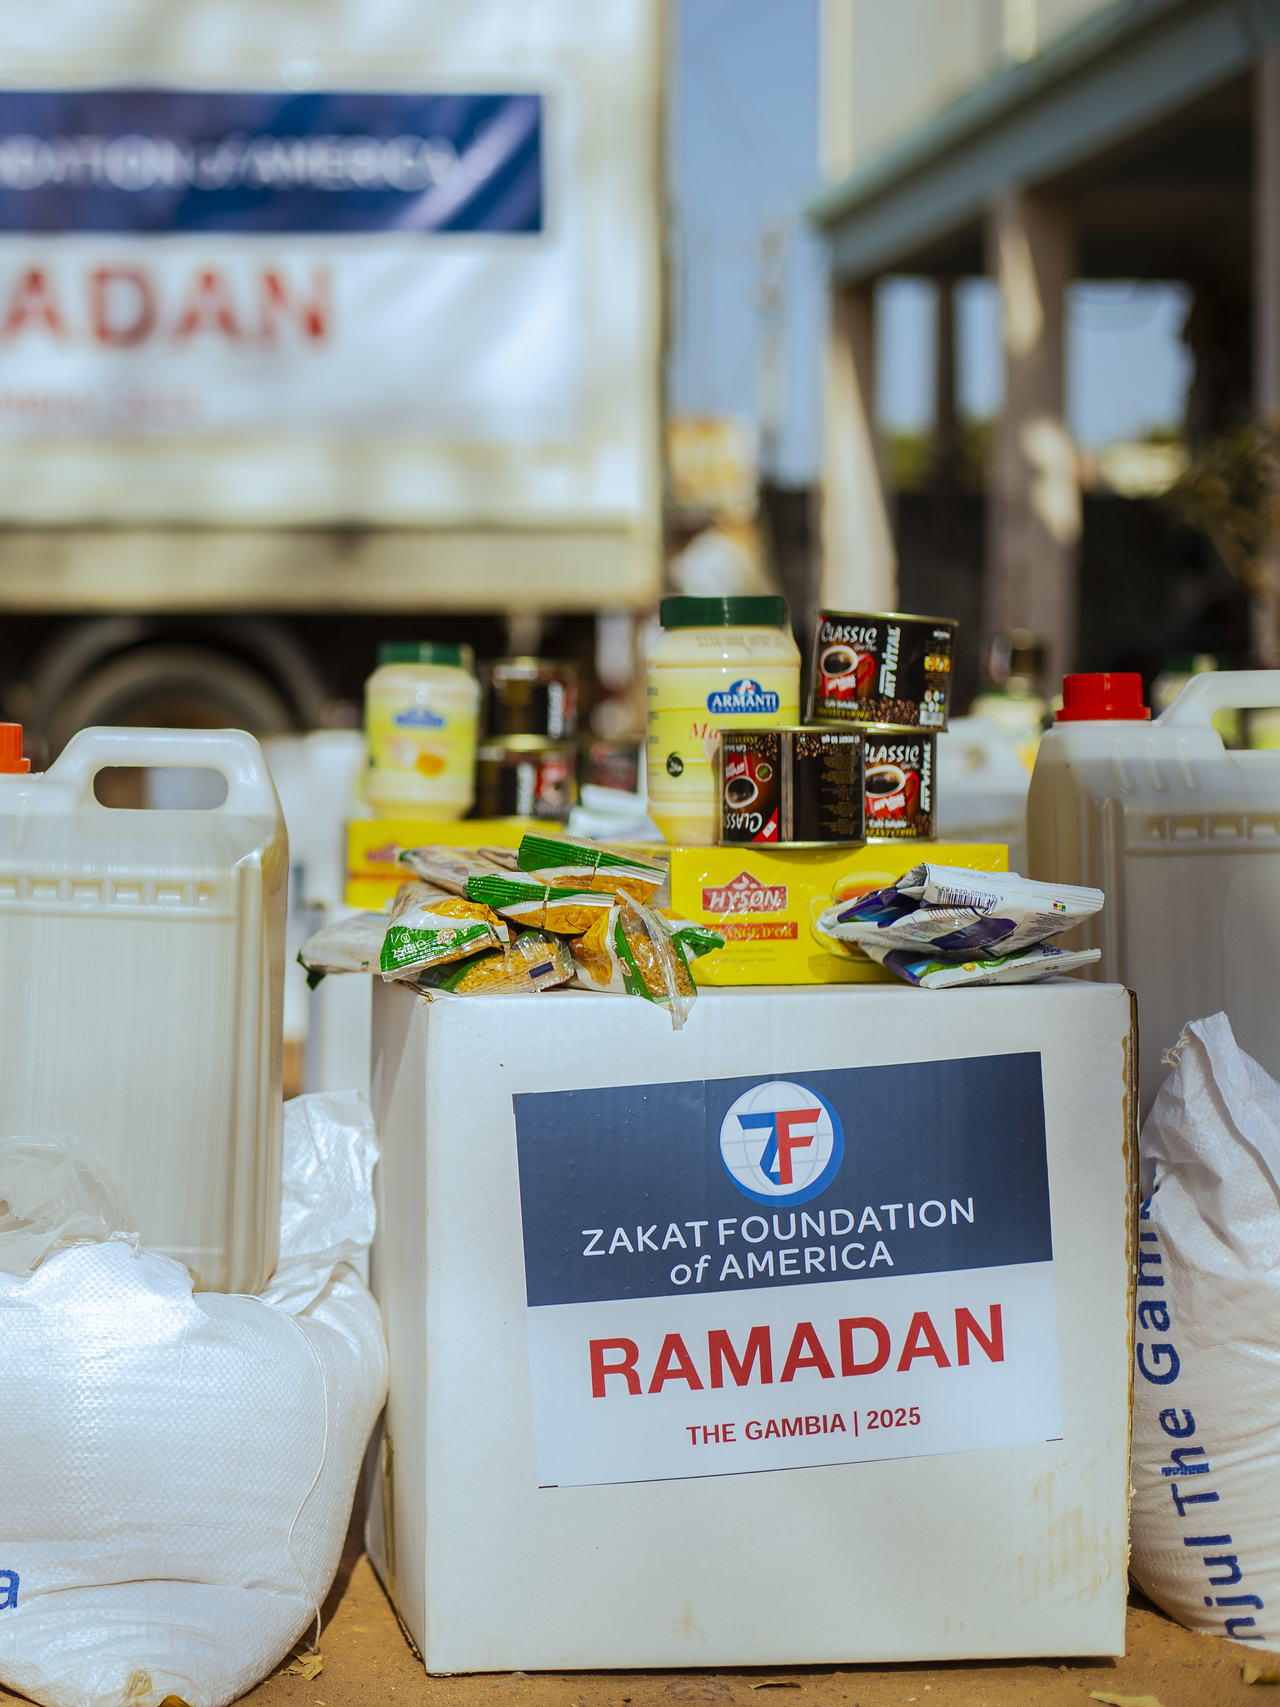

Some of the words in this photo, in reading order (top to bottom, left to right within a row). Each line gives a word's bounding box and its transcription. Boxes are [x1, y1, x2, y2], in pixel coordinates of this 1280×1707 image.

[820, 621, 877, 644] CLASSIC
[711, 694, 776, 707] ARMANTI
[709, 889, 780, 909] HYSON
[762, 925, 794, 938] D'OR
[581, 1220, 708, 1257] ZAKAT
[719, 1196, 975, 1246] FOUNDATION
[669, 1254, 712, 1286] of
[719, 1240, 894, 1282] AMERICA
[588, 1303, 1005, 1398] RAMADAN
[686, 1423, 737, 1446] THE
[744, 1412, 846, 1441] GAMBIA
[865, 1406, 922, 1431] 2025
[1158, 1406, 1220, 1517] The
